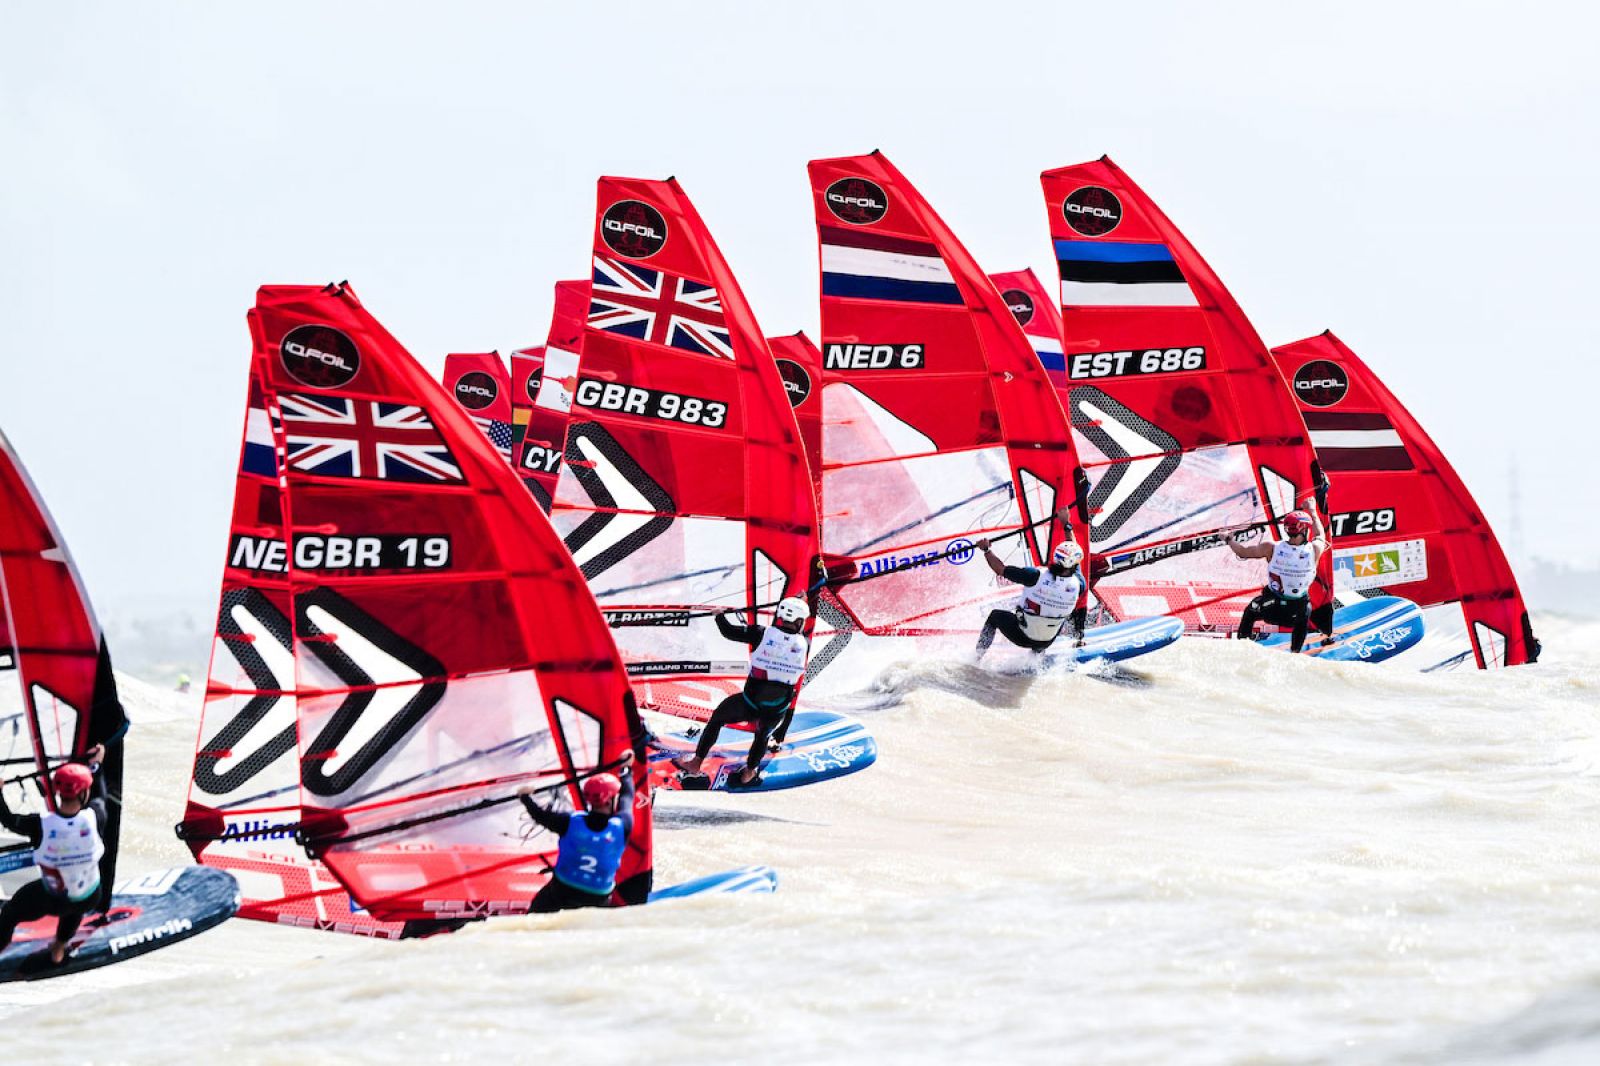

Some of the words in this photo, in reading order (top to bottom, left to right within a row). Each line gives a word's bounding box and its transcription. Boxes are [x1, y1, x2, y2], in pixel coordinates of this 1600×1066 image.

[826, 344, 894, 368] NED
[900, 345, 922, 368] 6
[1071, 351, 1133, 379] EST
[1140, 347, 1204, 373] 686
[576, 380, 650, 414] GBR
[657, 394, 726, 427] 983
[525, 446, 562, 474] CY
[1356, 509, 1394, 534] 29
[231, 536, 288, 572] NE
[295, 536, 382, 568] GBR
[398, 537, 449, 567] 19
[859, 550, 940, 579] Allianz
[579, 855, 598, 873] 2
